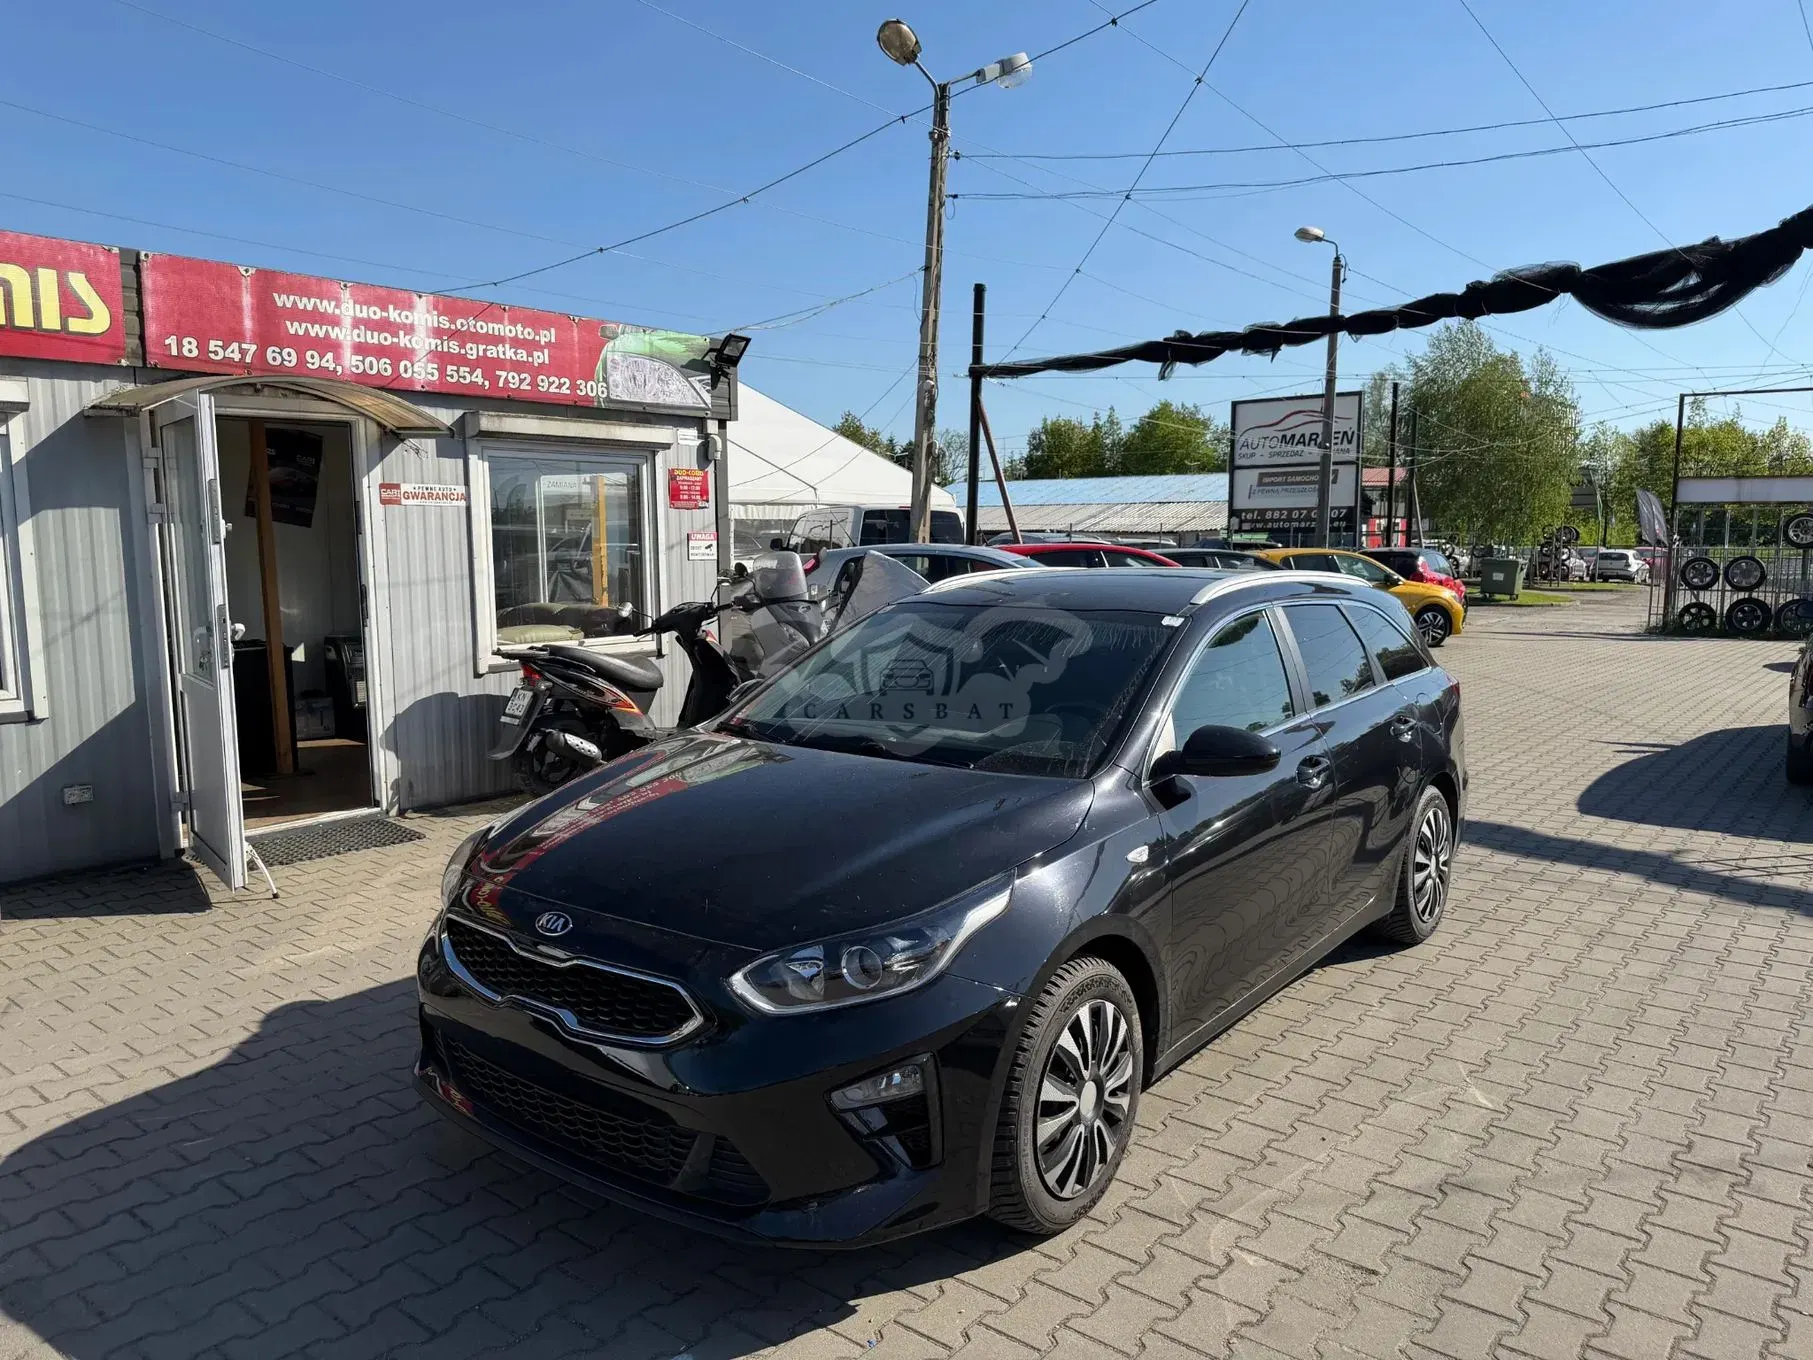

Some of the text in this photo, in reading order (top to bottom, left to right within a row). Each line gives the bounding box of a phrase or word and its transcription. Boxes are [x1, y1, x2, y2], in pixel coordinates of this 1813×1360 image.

[272, 293, 556, 345] www.duo-komis.otomoto.pl
[285, 320, 549, 366] www.duo-komis.gratka.pl
[164, 335, 608, 398] 18 547 69 94, 506 055 554, 792 922 306
[1239, 426, 1355, 451] AUTOMAREŃ
[1238, 452, 1256, 460] SKUP
[403, 491, 466, 502] GWARANCJA
[1241, 511, 1260, 520] tel.
[1265, 510, 1287, 519] 882
[1292, 510, 1307, 519] 07
[1331, 509, 1347, 518] 07
